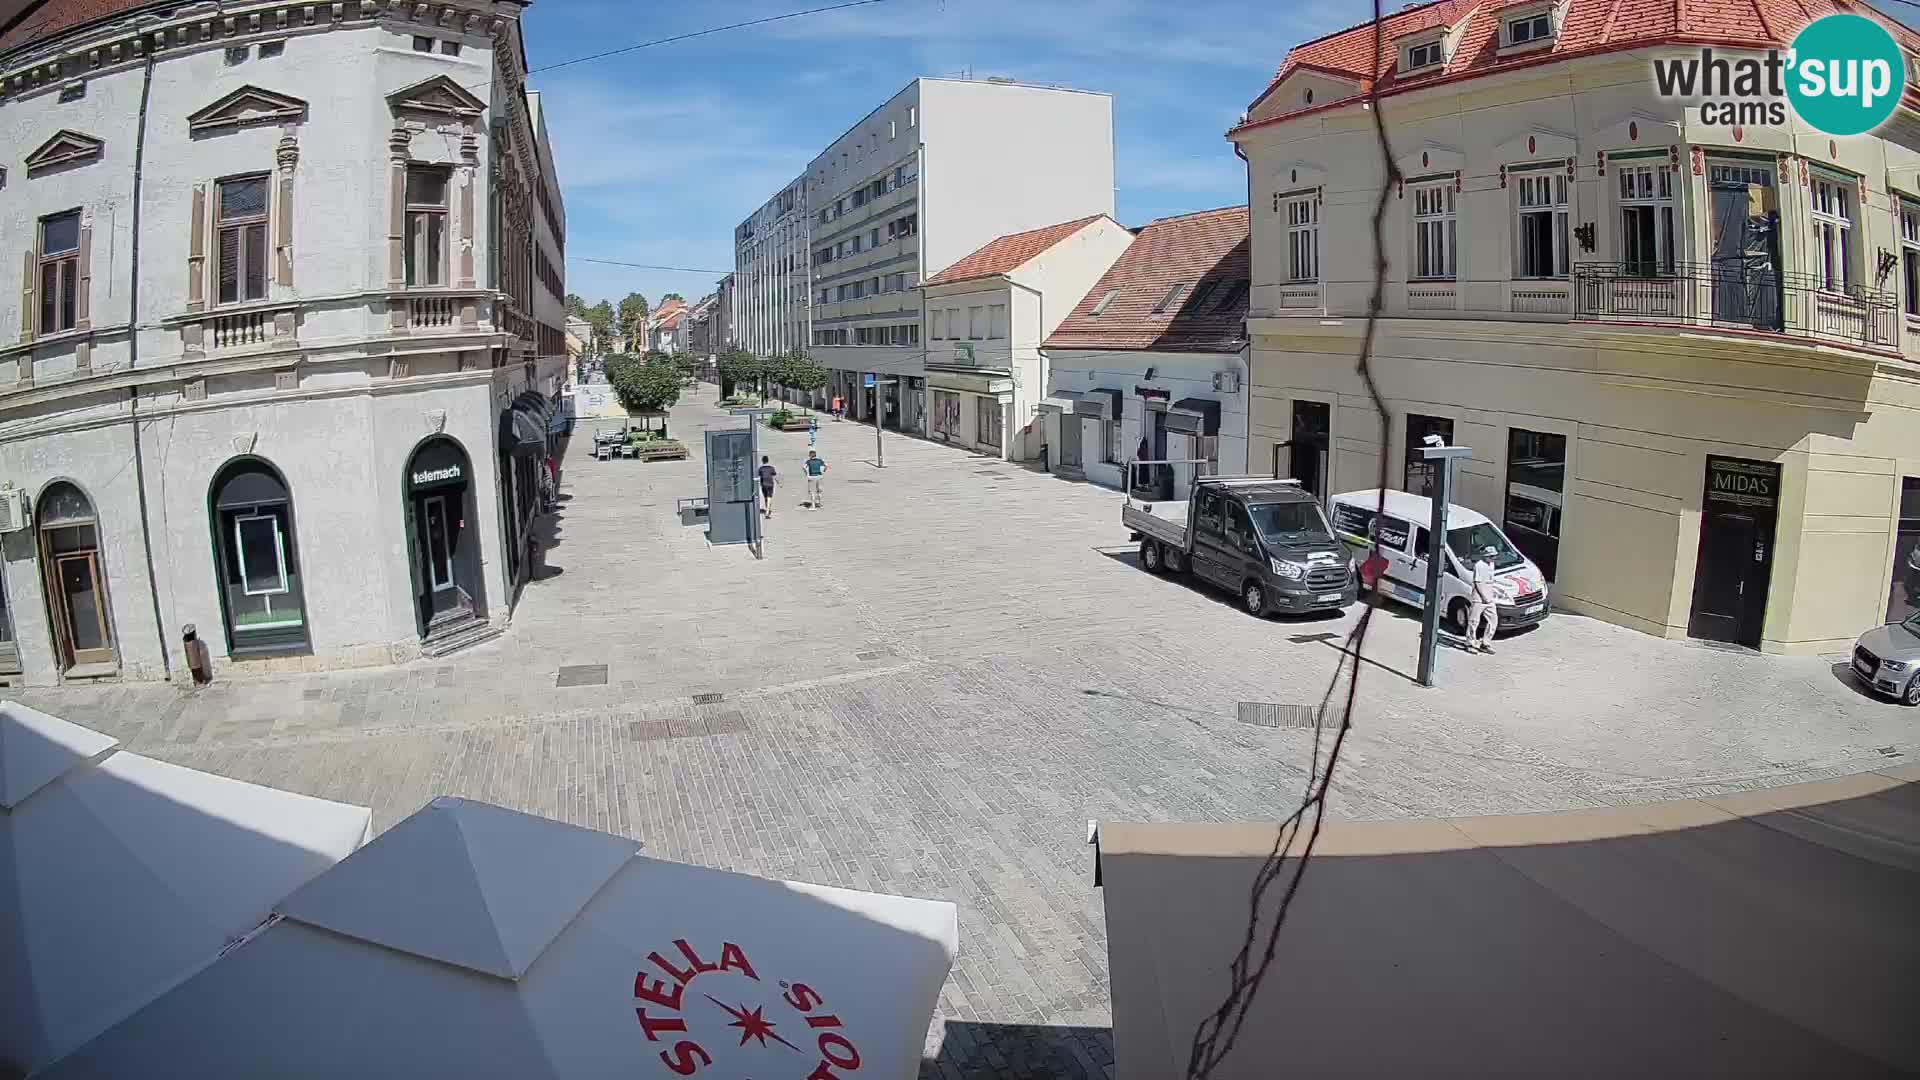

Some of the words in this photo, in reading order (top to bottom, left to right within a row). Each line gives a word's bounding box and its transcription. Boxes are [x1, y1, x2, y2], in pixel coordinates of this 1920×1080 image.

[414, 465, 460, 483] telemach
[1714, 472, 1769, 494] MIDAS
[634, 938, 761, 1076] STELLA
